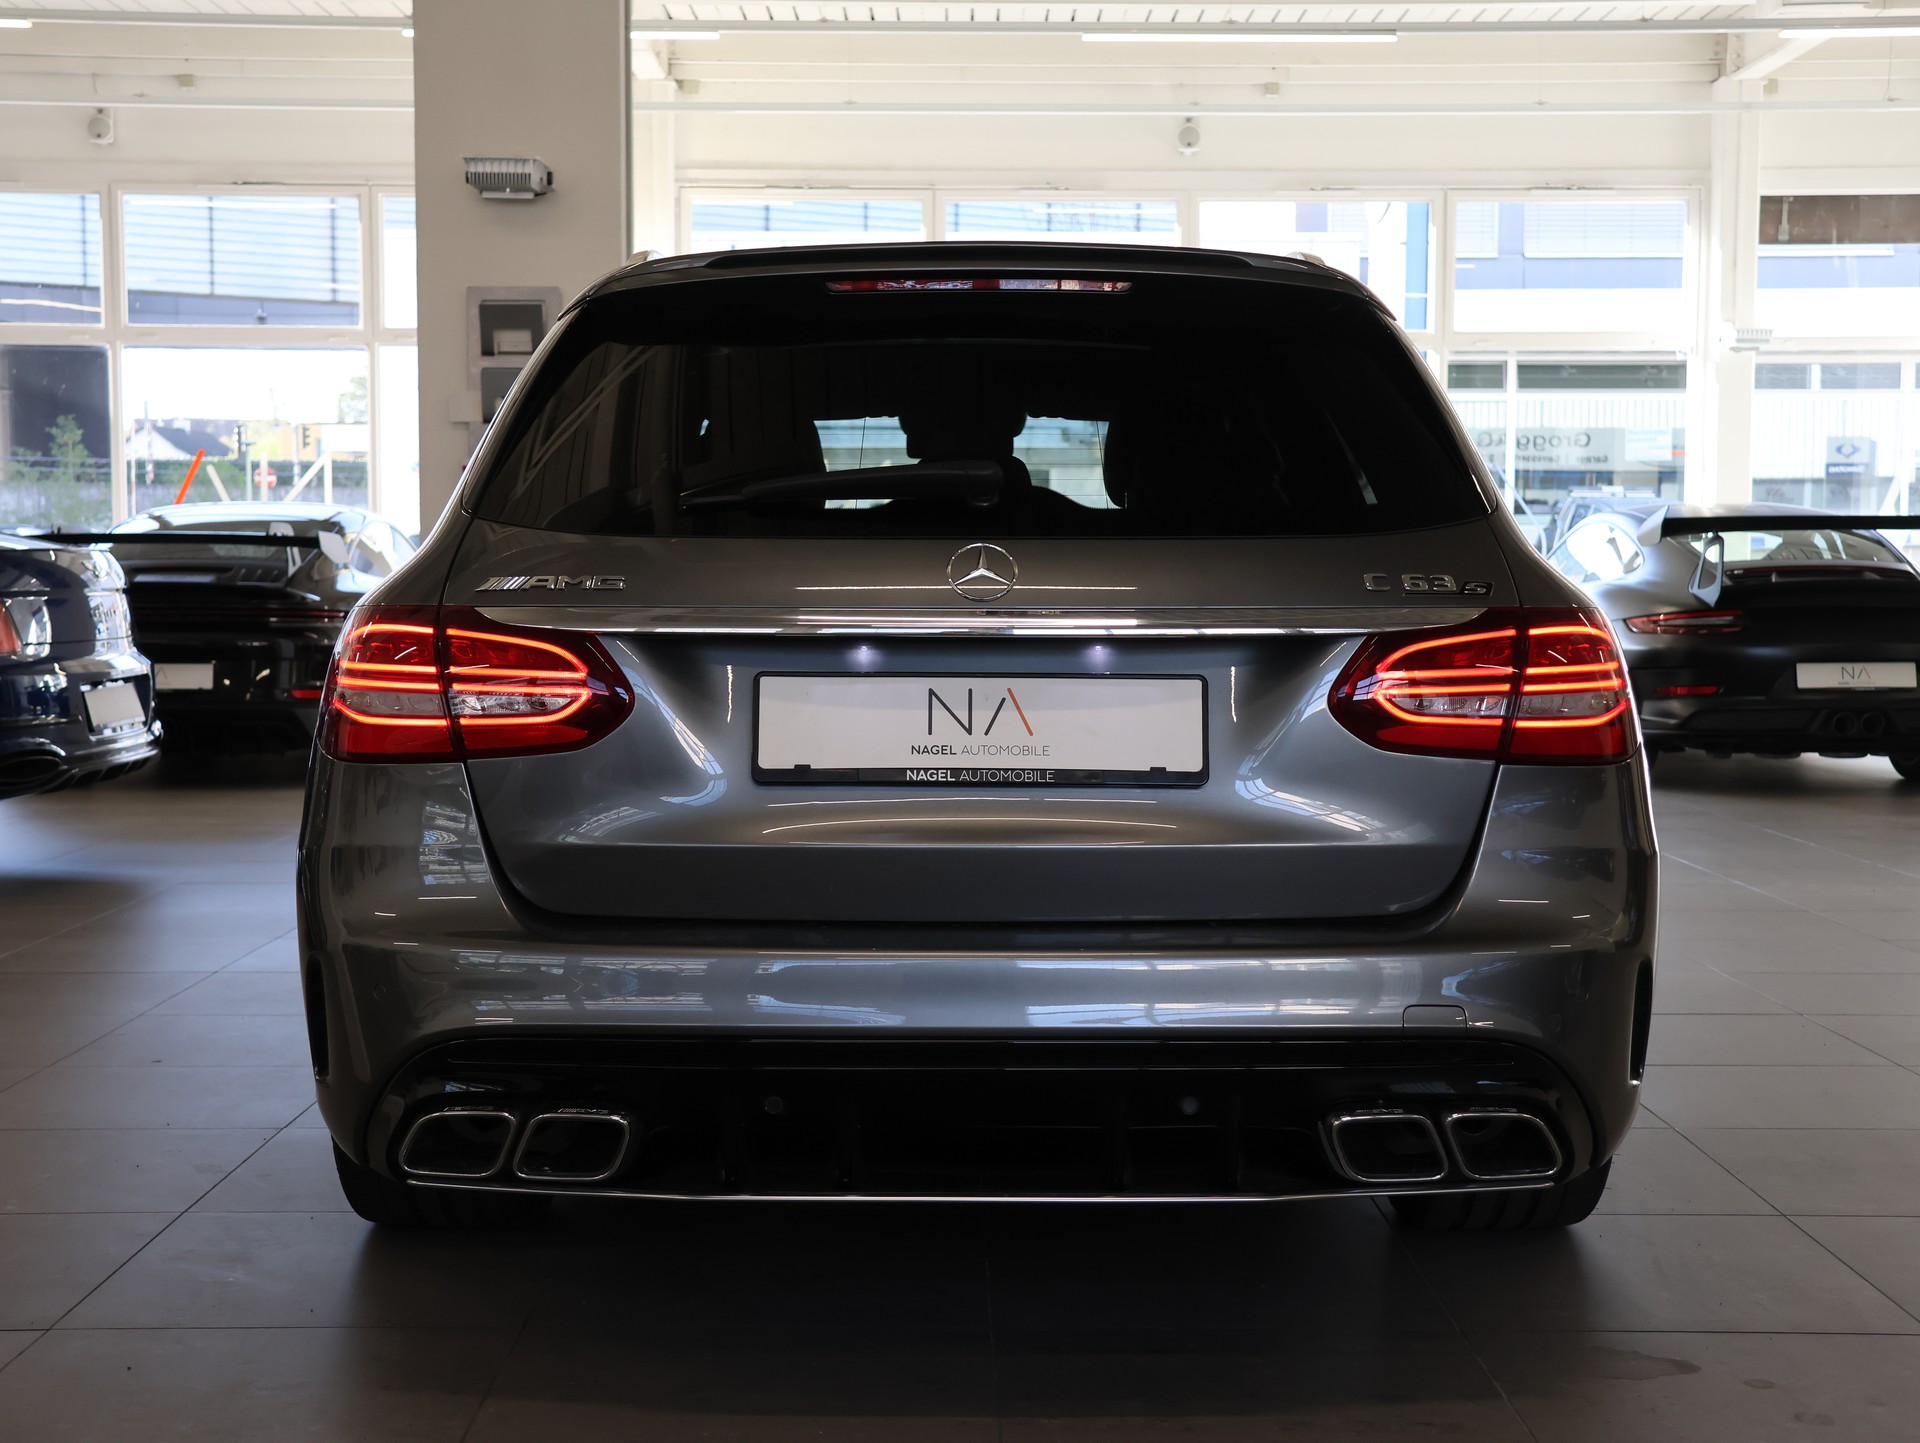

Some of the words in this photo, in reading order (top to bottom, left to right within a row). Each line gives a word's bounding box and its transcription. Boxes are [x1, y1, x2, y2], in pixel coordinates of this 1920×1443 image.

[521, 575, 626, 590] AMG
[1363, 573, 1391, 591] C
[1401, 574, 1457, 591] 63
[927, 687, 1034, 736] NA
[911, 744, 957, 755] NAGEL
[960, 745, 1050, 756] AUTOMOBILE
[906, 769, 955, 781] NAGEL
[959, 770, 1055, 782] AUTOMOBILE
